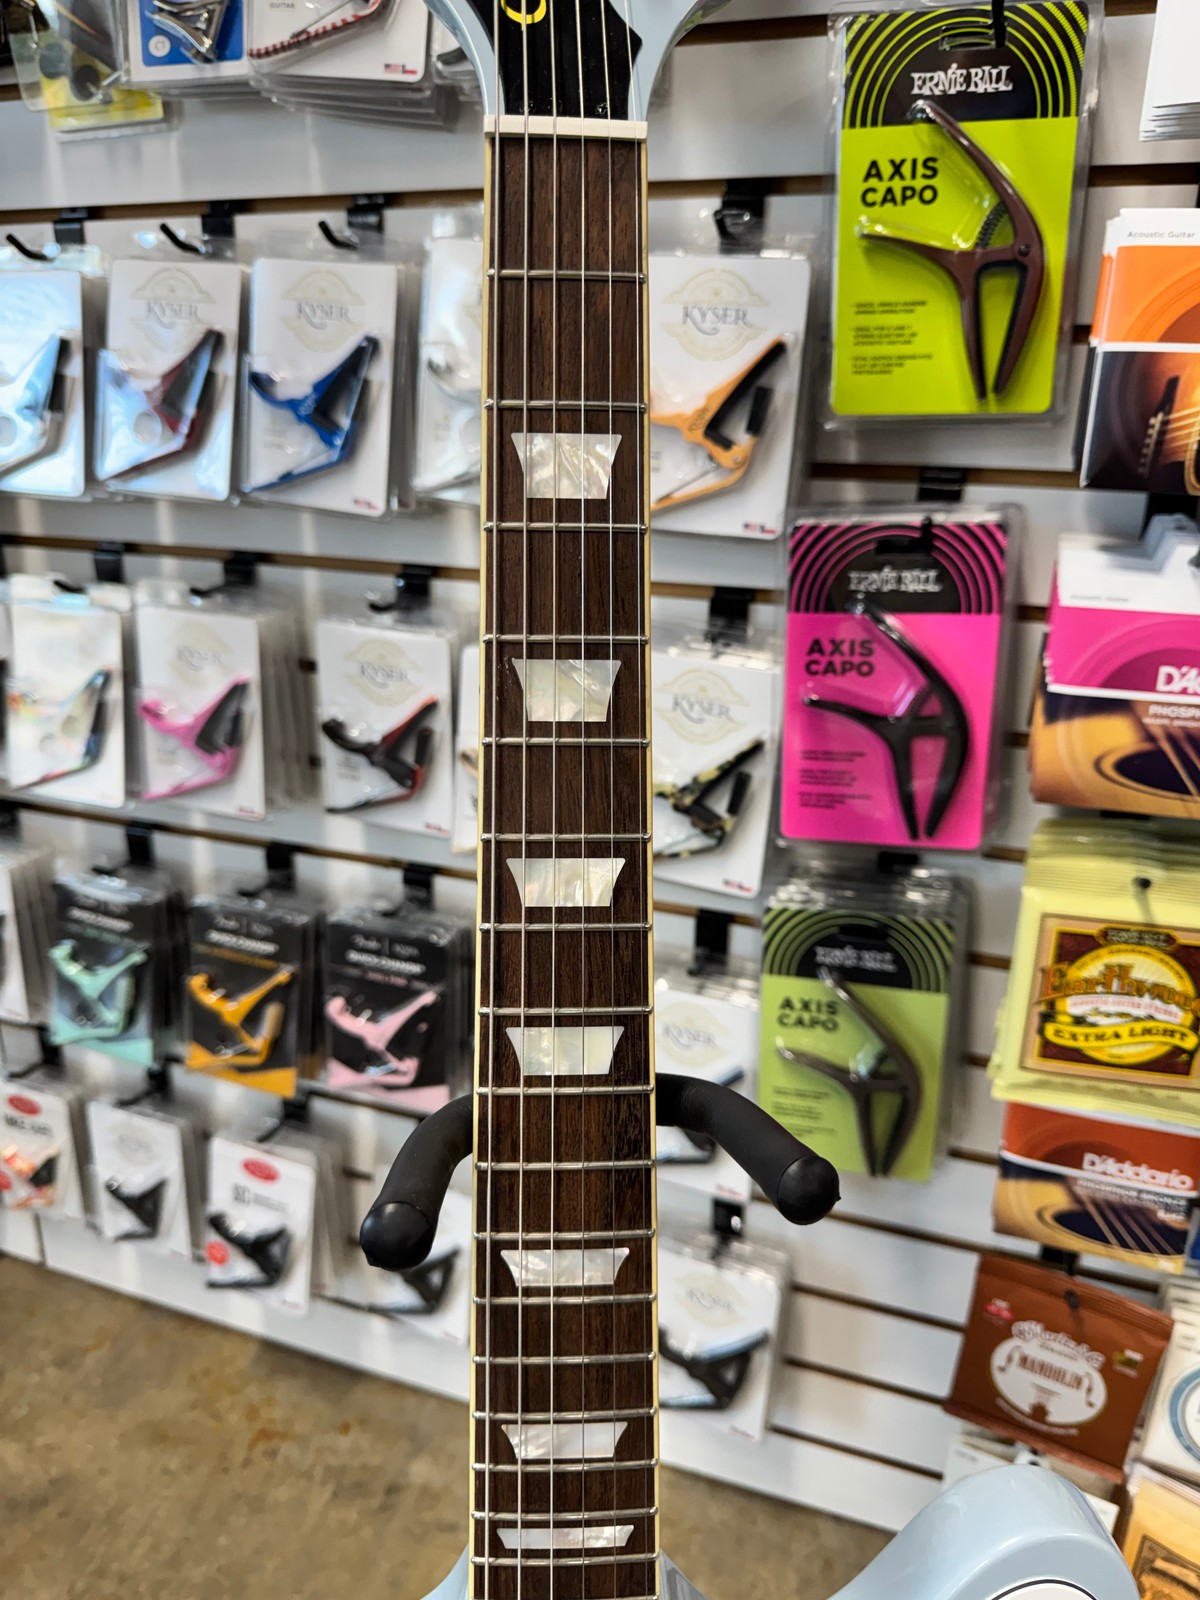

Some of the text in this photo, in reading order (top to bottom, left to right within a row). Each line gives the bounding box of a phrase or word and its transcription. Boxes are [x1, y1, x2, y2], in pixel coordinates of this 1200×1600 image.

[967, 66, 1013, 94] BALL
[863, 157, 938, 183] AXIS
[861, 185, 938, 208] CAPO
[1127, 231, 1196, 239] Acoustic Guitar
[682, 304, 754, 336] KYSER
[807, 638, 874, 657] AXIS
[805, 660, 875, 677] CAPO
[780, 998, 838, 1015] AXIS
[778, 1013, 839, 1032] CAPO
[1053, 1026, 1188, 1042] EXTRA LIGHT
[1018, 1352, 1083, 1391] MANDOLIN
